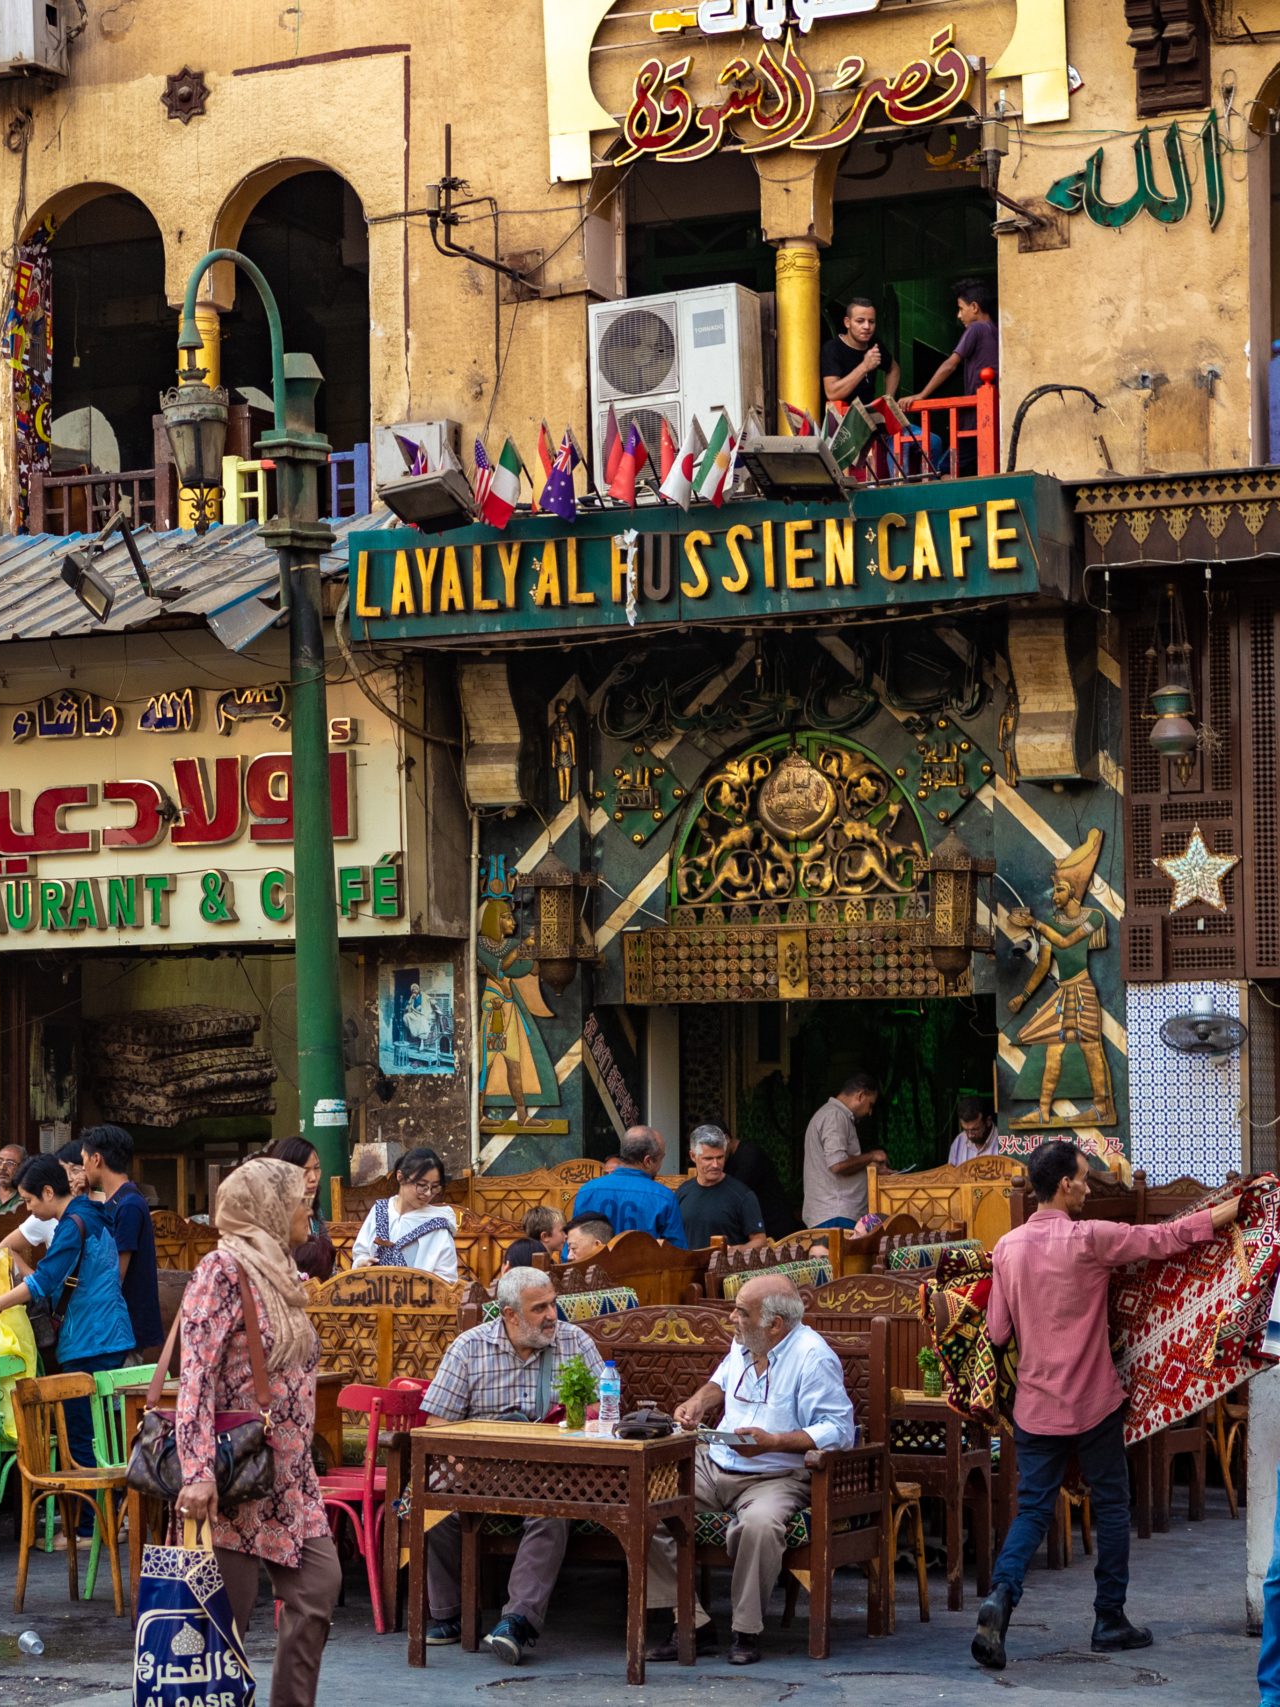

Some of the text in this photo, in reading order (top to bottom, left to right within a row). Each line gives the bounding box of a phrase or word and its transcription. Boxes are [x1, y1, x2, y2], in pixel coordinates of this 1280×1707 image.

[790, 23, 972, 150] قصر
[1045, 108, 1225, 233] الله
[694, 323, 724, 334] TORNADO
[357, 498, 1019, 617] LAYALY AL HUSSIEN CAFE
[137, 689, 194, 733] الله
[200, 869, 234, 923] &
[261, 851, 404, 920] CFÉ
[151, 1651, 223, 1693] القصر
